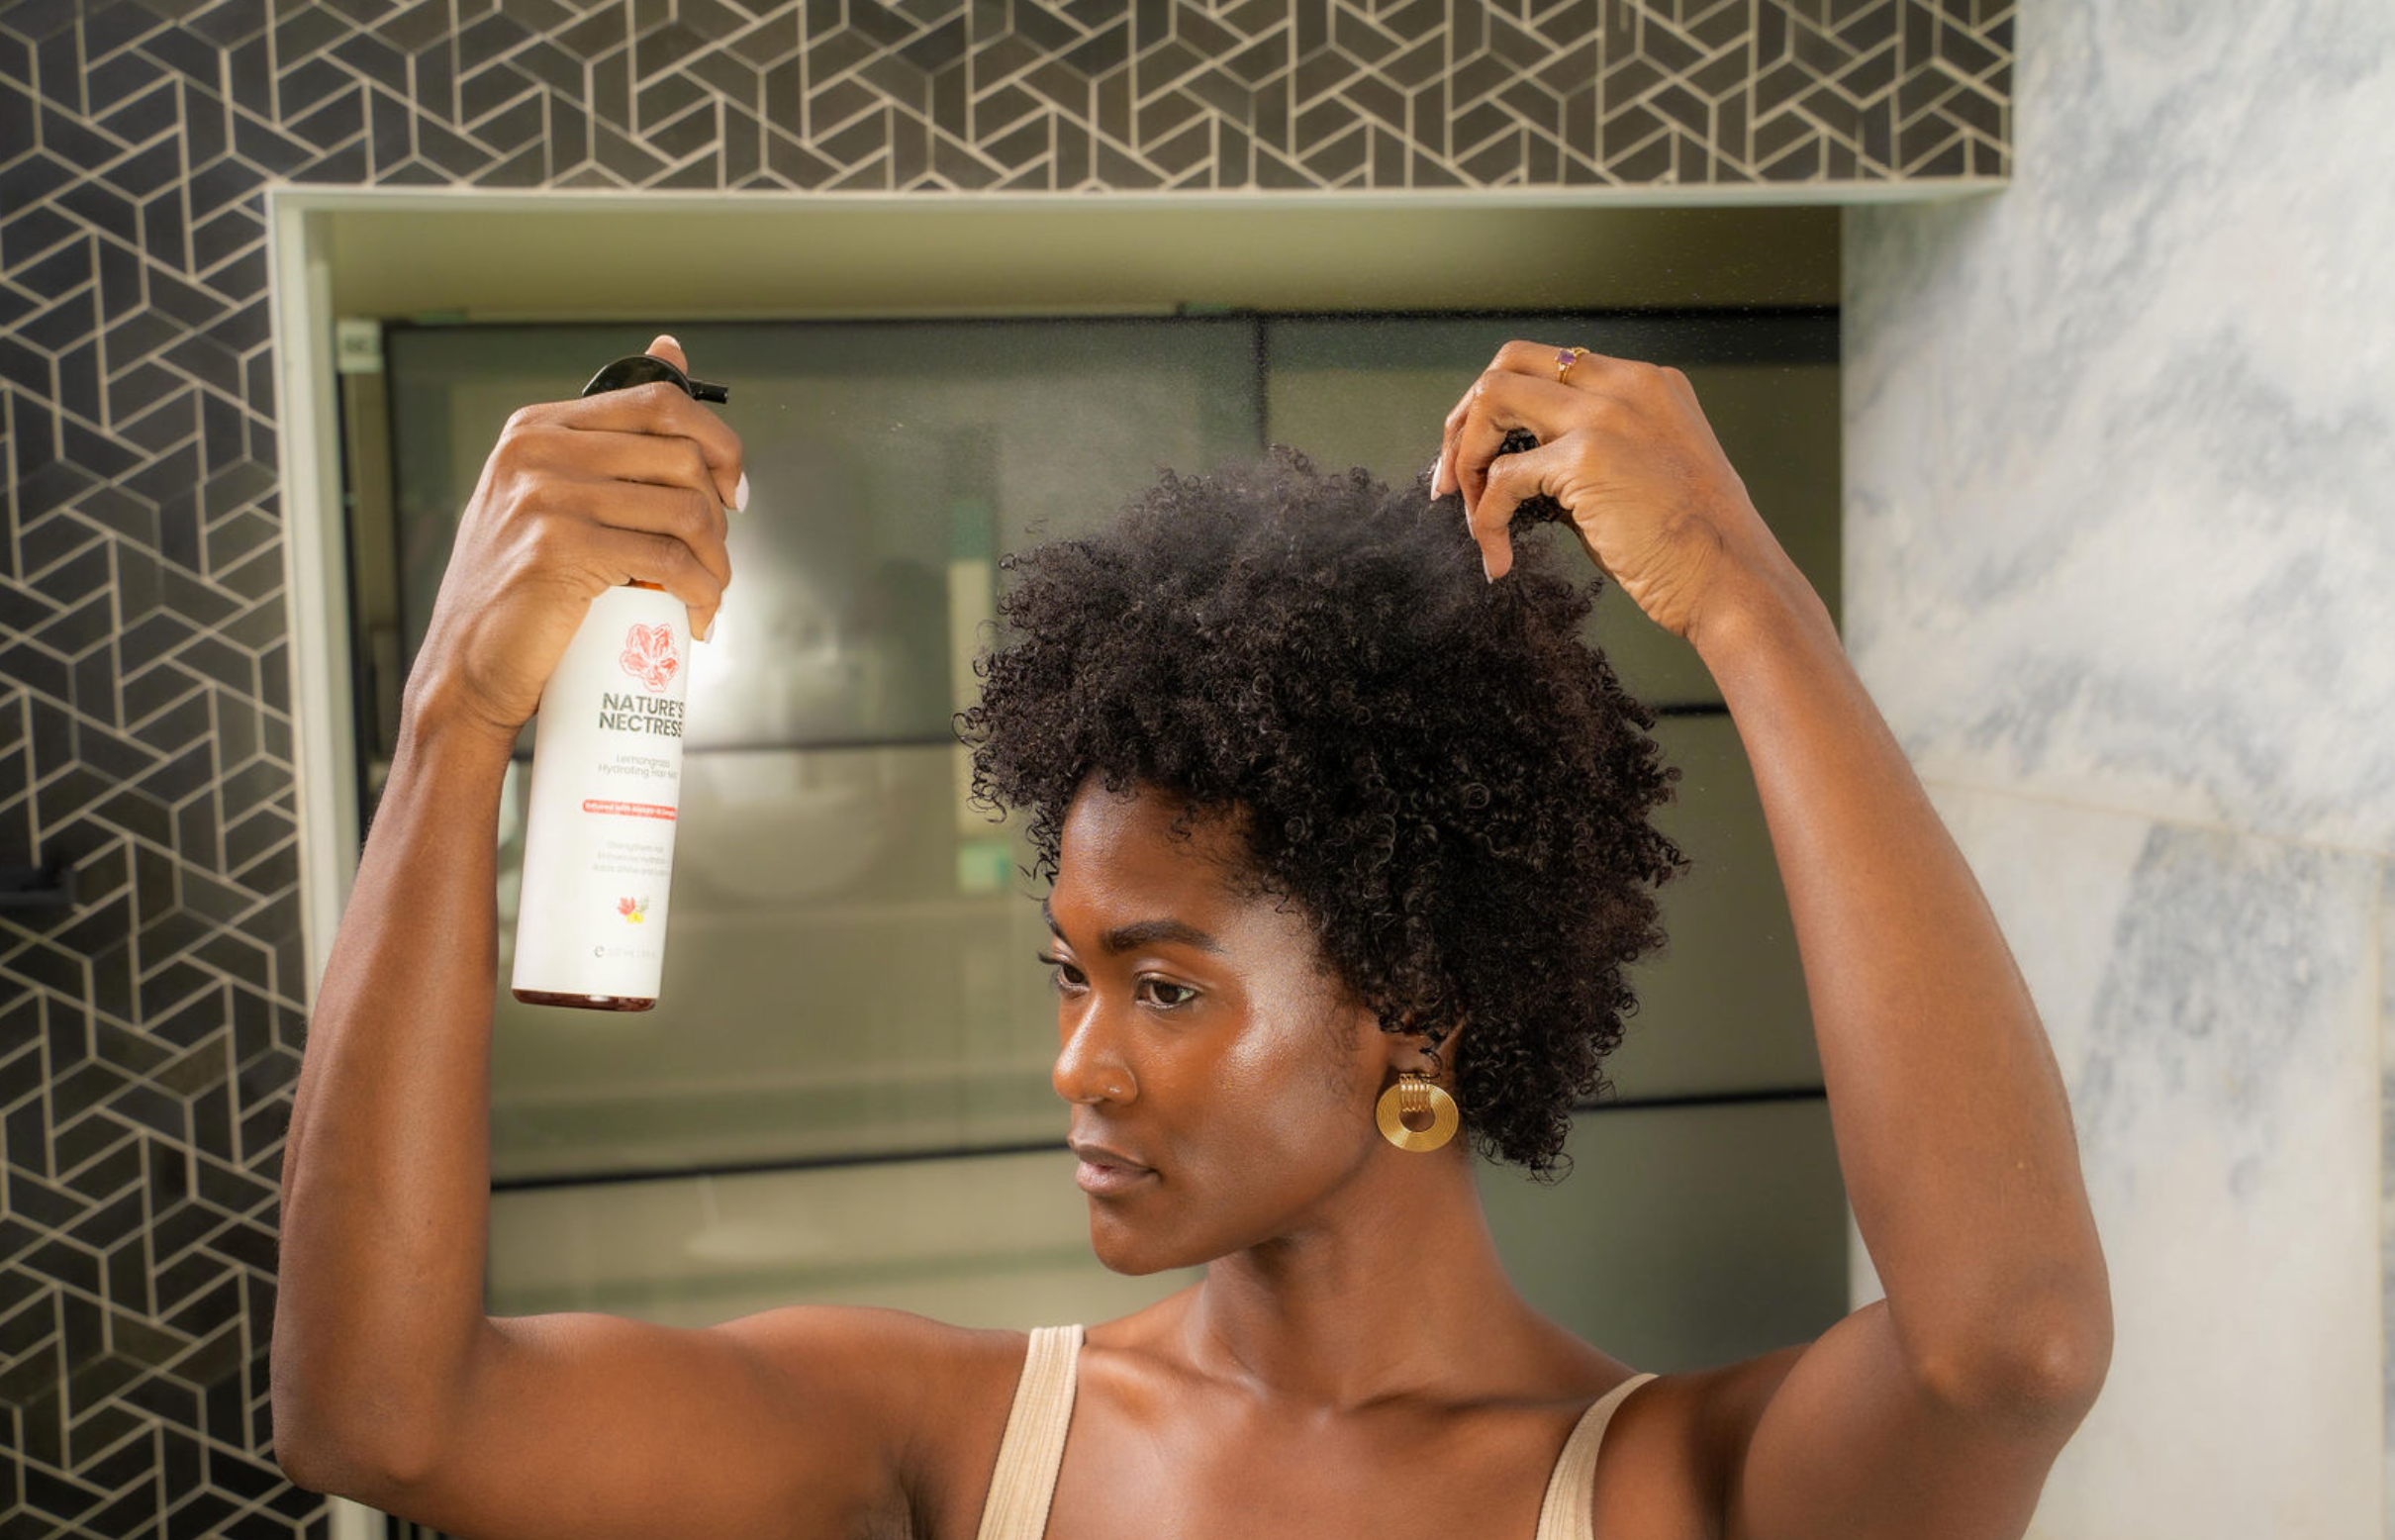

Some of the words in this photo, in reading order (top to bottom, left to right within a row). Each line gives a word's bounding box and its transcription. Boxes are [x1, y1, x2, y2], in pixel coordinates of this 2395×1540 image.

[602, 693, 683, 719] NATURE'S
[599, 712, 682, 737] NECTRESS
[598, 763, 649, 779] Hydrating
